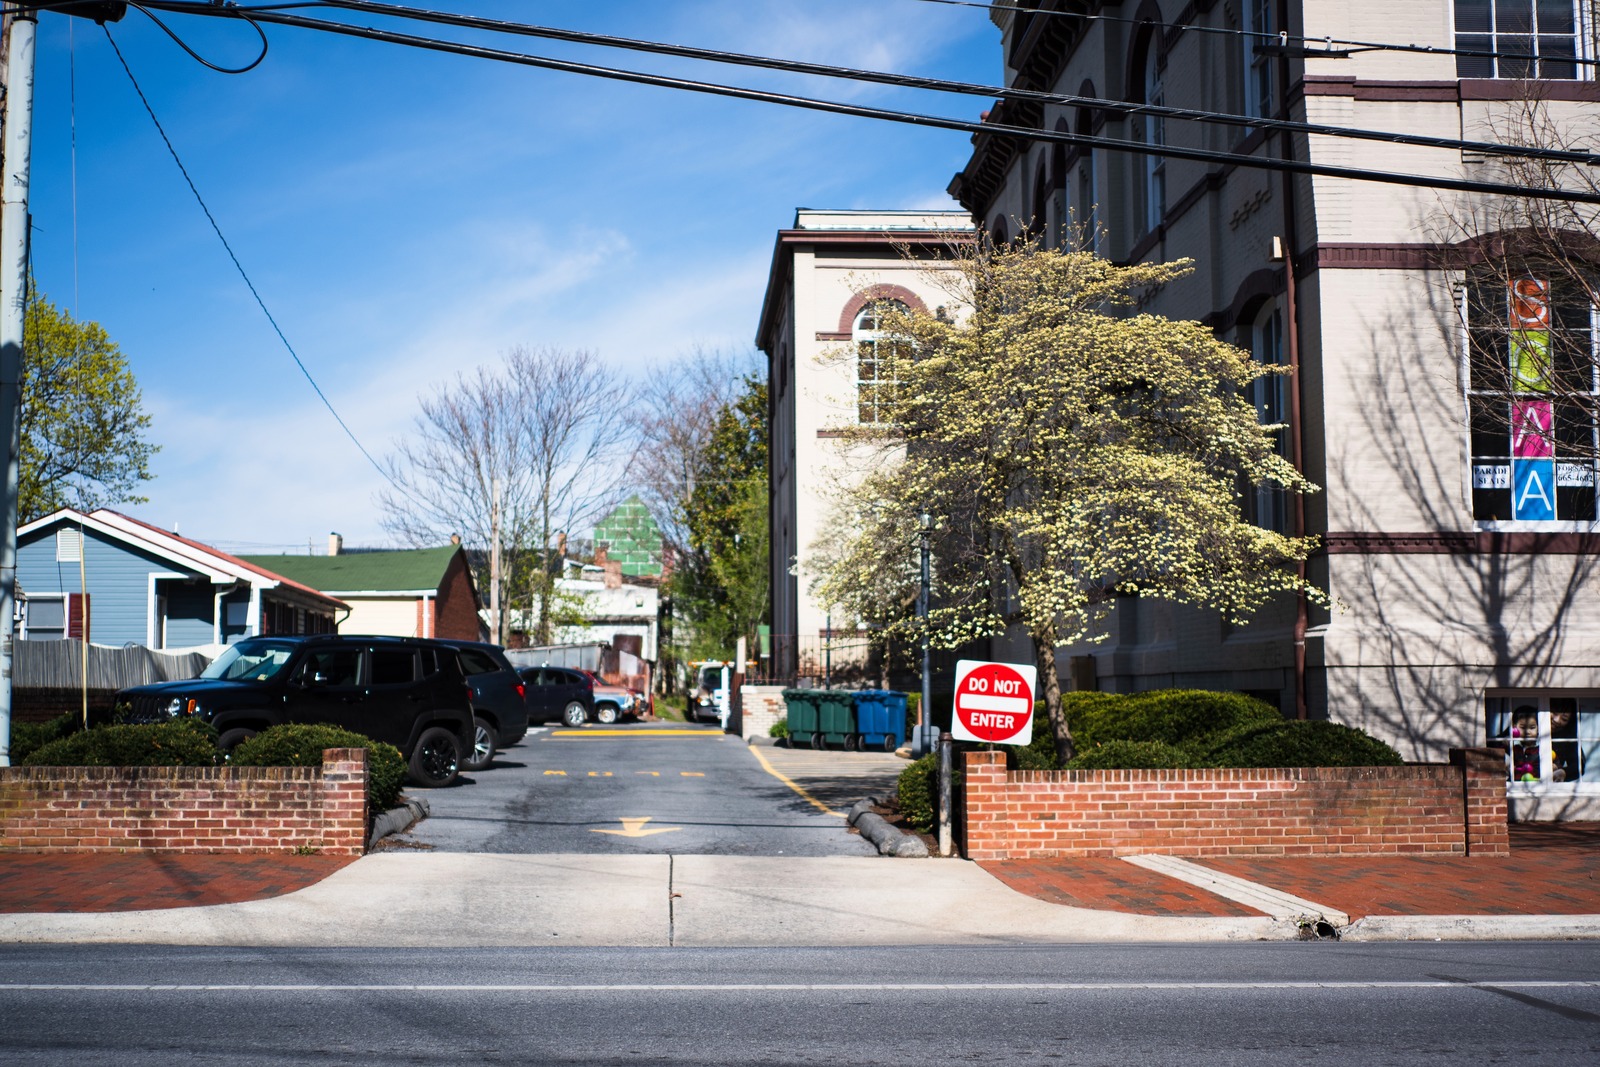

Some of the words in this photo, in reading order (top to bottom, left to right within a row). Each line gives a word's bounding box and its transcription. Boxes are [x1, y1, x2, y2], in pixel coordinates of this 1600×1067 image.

[1478, 477, 1506, 485] SEATS
[968, 677, 988, 692] DO
[993, 679, 1021, 695] NOT
[970, 712, 1014, 729] ENTER
